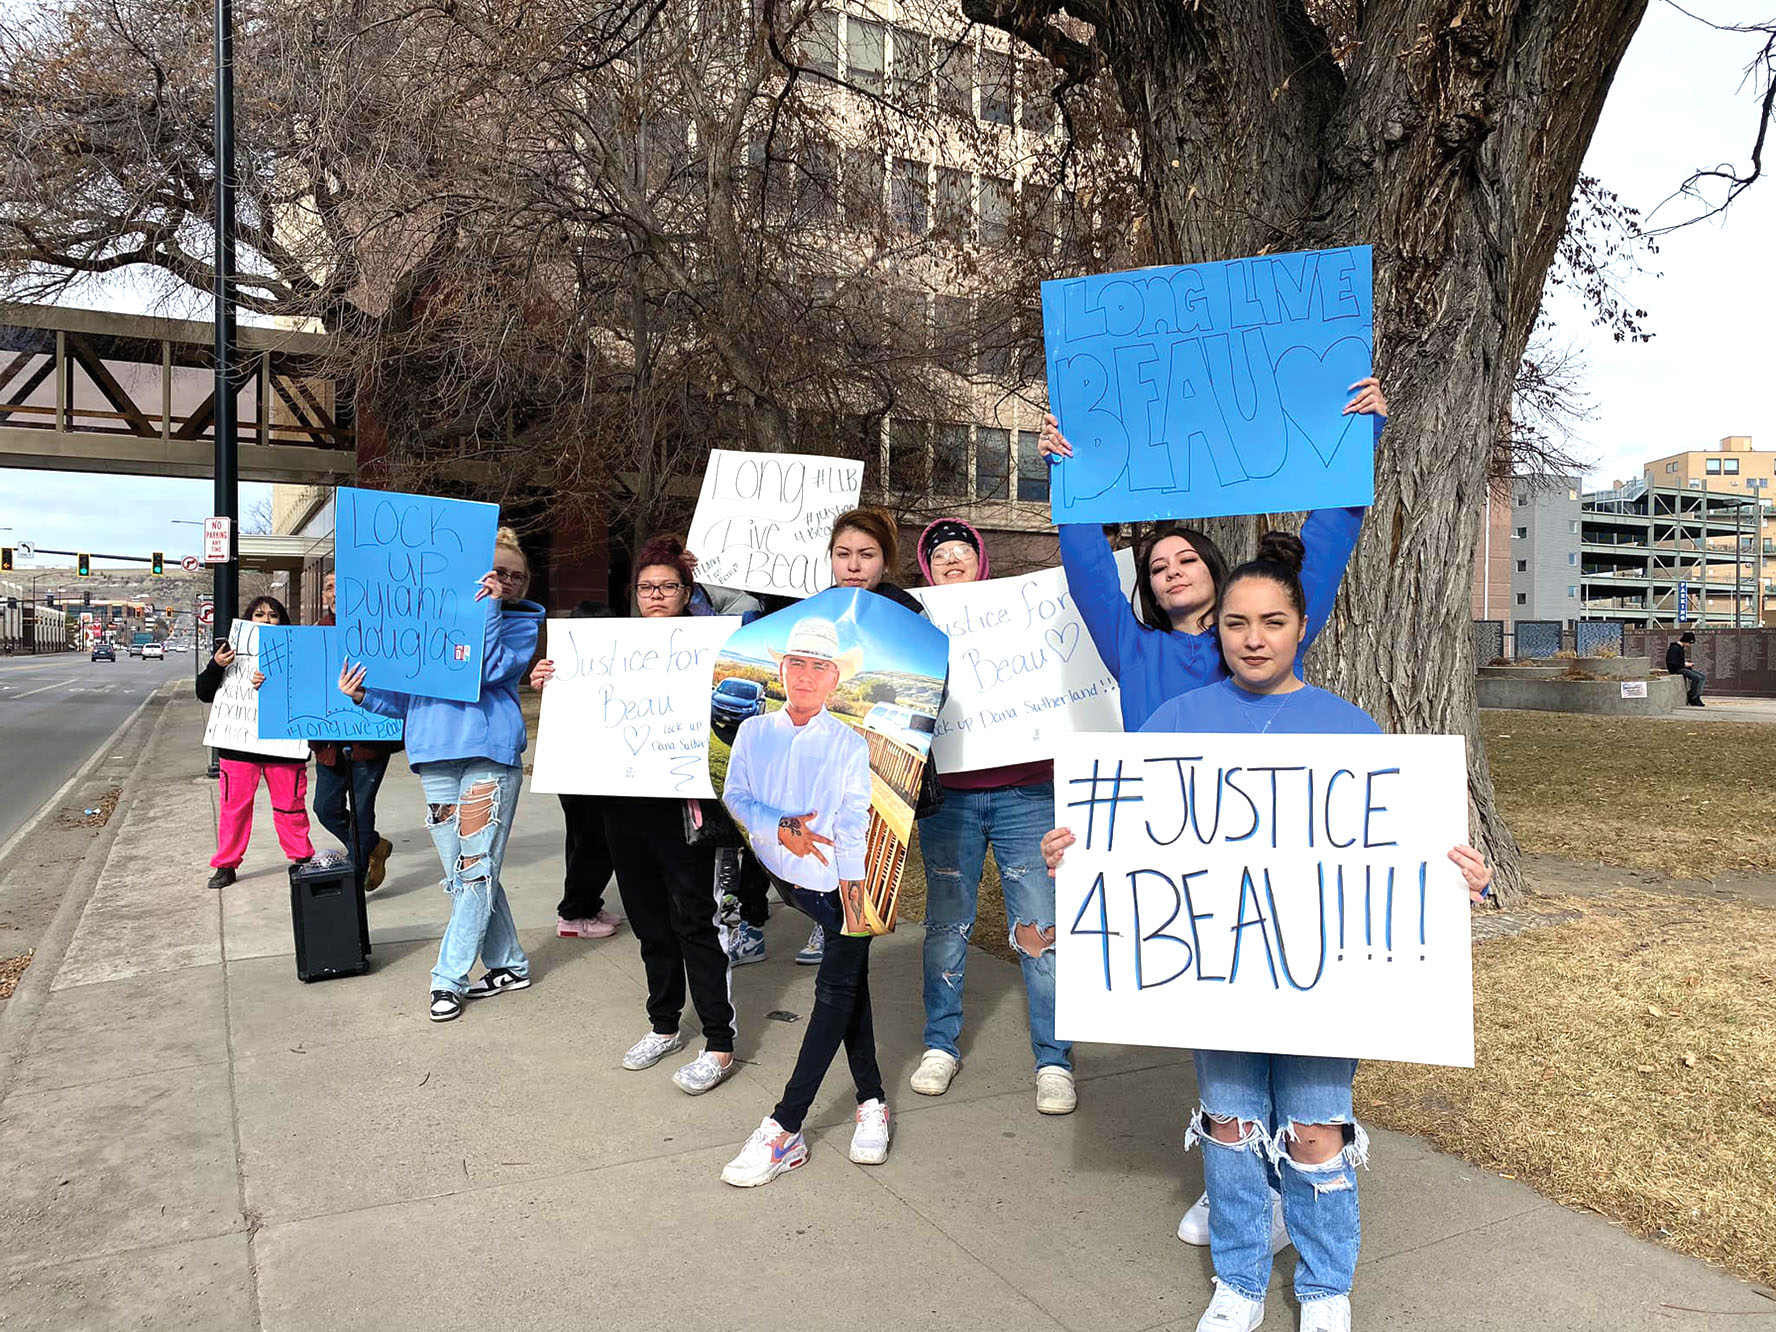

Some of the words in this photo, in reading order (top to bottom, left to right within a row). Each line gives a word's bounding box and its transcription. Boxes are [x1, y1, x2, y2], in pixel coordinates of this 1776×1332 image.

[1225, 250, 1360, 329] LIVE
[1055, 327, 1288, 508] BEAU
[206, 531, 228, 539] PARKING
[211, 520, 222, 530] NO
[1020, 581, 1070, 631] for
[962, 648, 1048, 693] Beau
[599, 684, 674, 728] Beau
[933, 719, 954, 737] ock
[979, 709, 1018, 728] Dana
[651, 740, 676, 751] Dana
[1067, 756, 1401, 851] #JUSTICE
